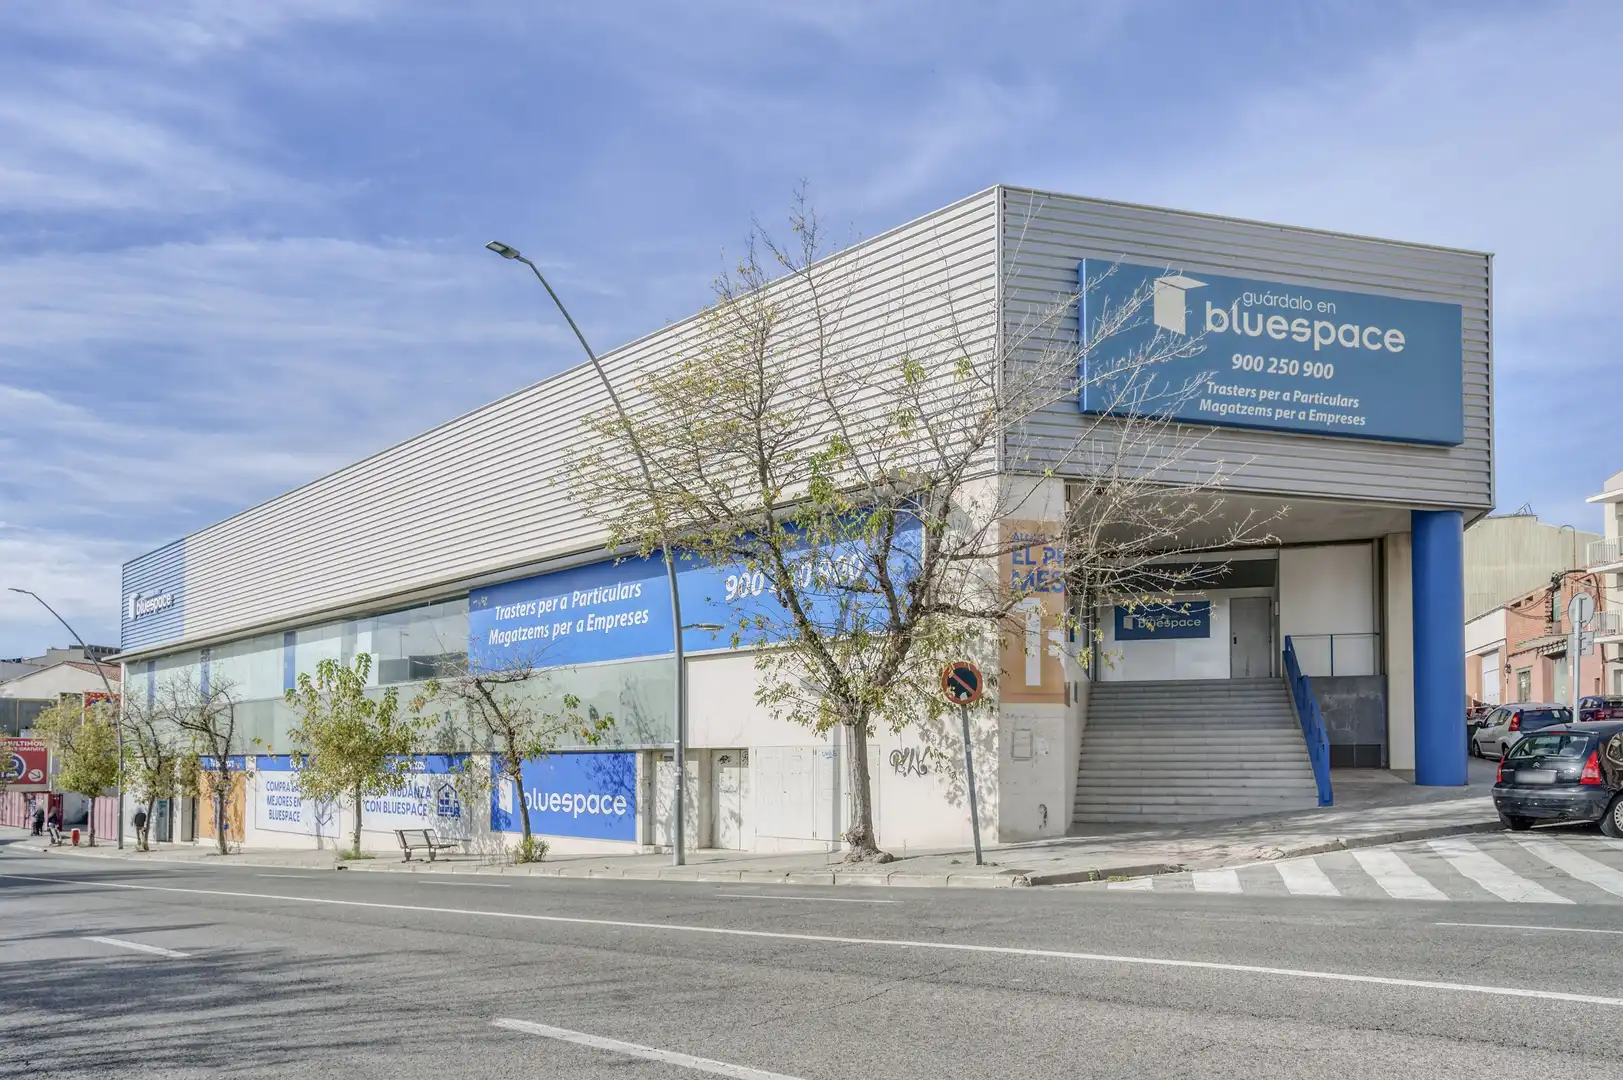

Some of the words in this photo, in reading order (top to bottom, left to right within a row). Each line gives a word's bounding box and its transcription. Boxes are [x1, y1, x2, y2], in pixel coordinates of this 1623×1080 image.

[1242, 291, 1313, 312] guárdalo
[1317, 300, 1337, 314] en
[1205, 301, 1405, 353] bluespace
[1232, 353, 1264, 372] 900
[1267, 357, 1299, 376] 250
[1303, 362, 1335, 380] 900
[1207, 381, 1257, 398] Trasters
[1259, 388, 1280, 402] per
[1283, 391, 1291, 402] a
[1293, 390, 1360, 409] Particulars
[1199, 399, 1272, 417] Magatzems
[1275, 407, 1296, 421] per
[1298, 411, 1306, 421] a
[1308, 409, 1366, 426] Empreses
[1012, 546, 1037, 565] EL
[725, 570, 764, 601] 900
[495, 601, 536, 621] Trasters
[538, 599, 557, 618] per
[559, 596, 567, 610] a
[571, 582, 642, 609] Particulars
[488, 623, 550, 647] Magatzems
[552, 620, 573, 641] per
[576, 619, 584, 633] a
[586, 609, 649, 634] Empreses
[266, 781, 290, 793] COMPRA
[266, 795, 293, 807] MEJORES
[293, 797, 302, 808] EN
[268, 808, 301, 822] BLUESPACE
[365, 800, 382, 813] CON
[383, 801, 428, 816] BLUESPACE
